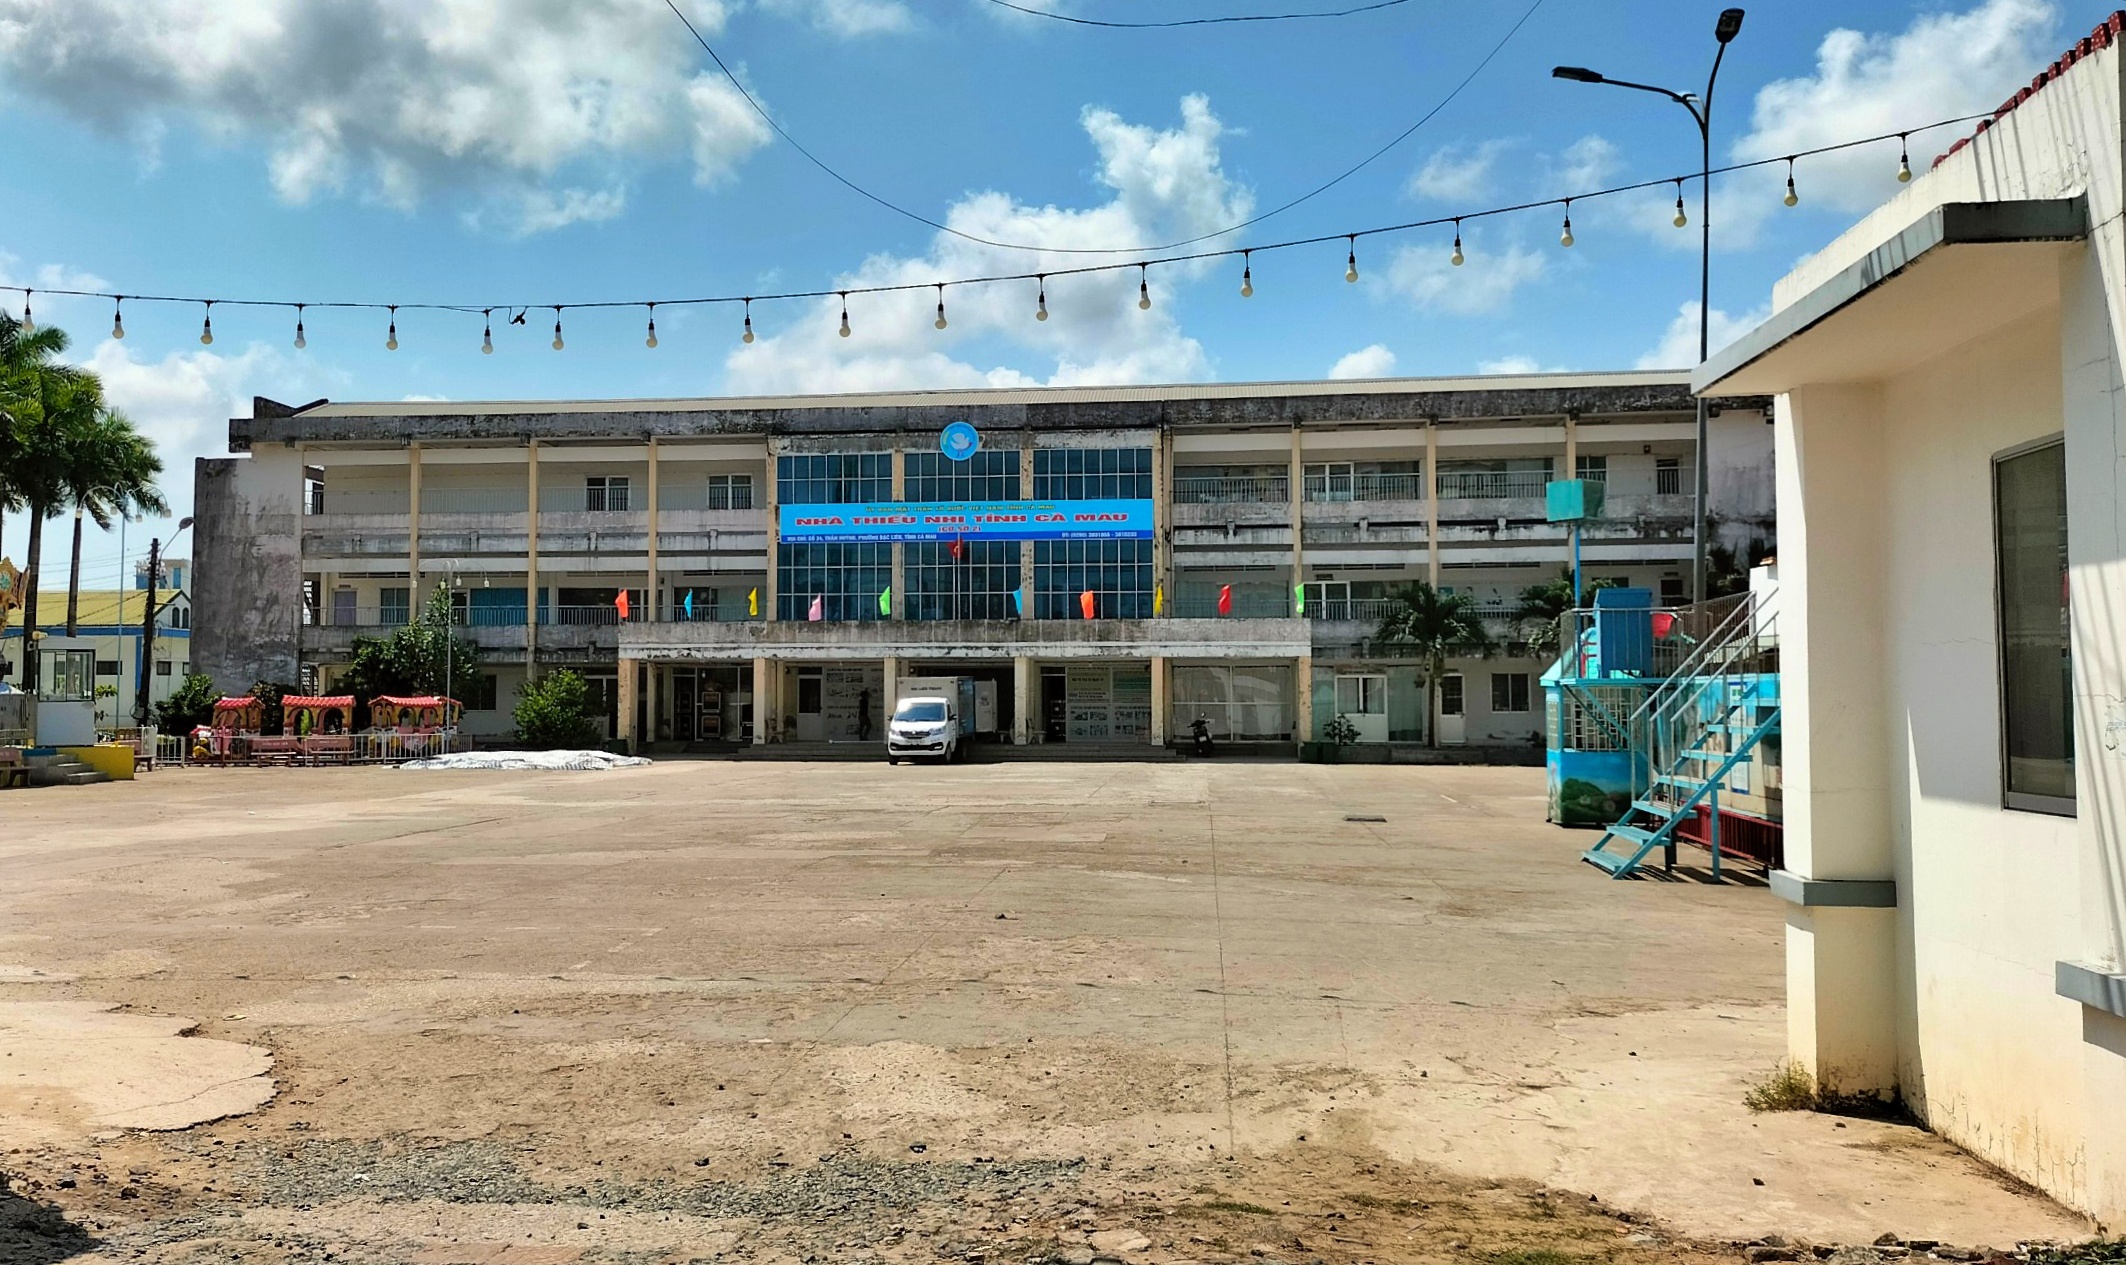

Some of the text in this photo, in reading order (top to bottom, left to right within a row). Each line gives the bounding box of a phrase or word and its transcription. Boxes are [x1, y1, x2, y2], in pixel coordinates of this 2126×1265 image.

[795, 511, 1129, 525] NHÀ THIẾU NHI TỈNH CÀ MAU
